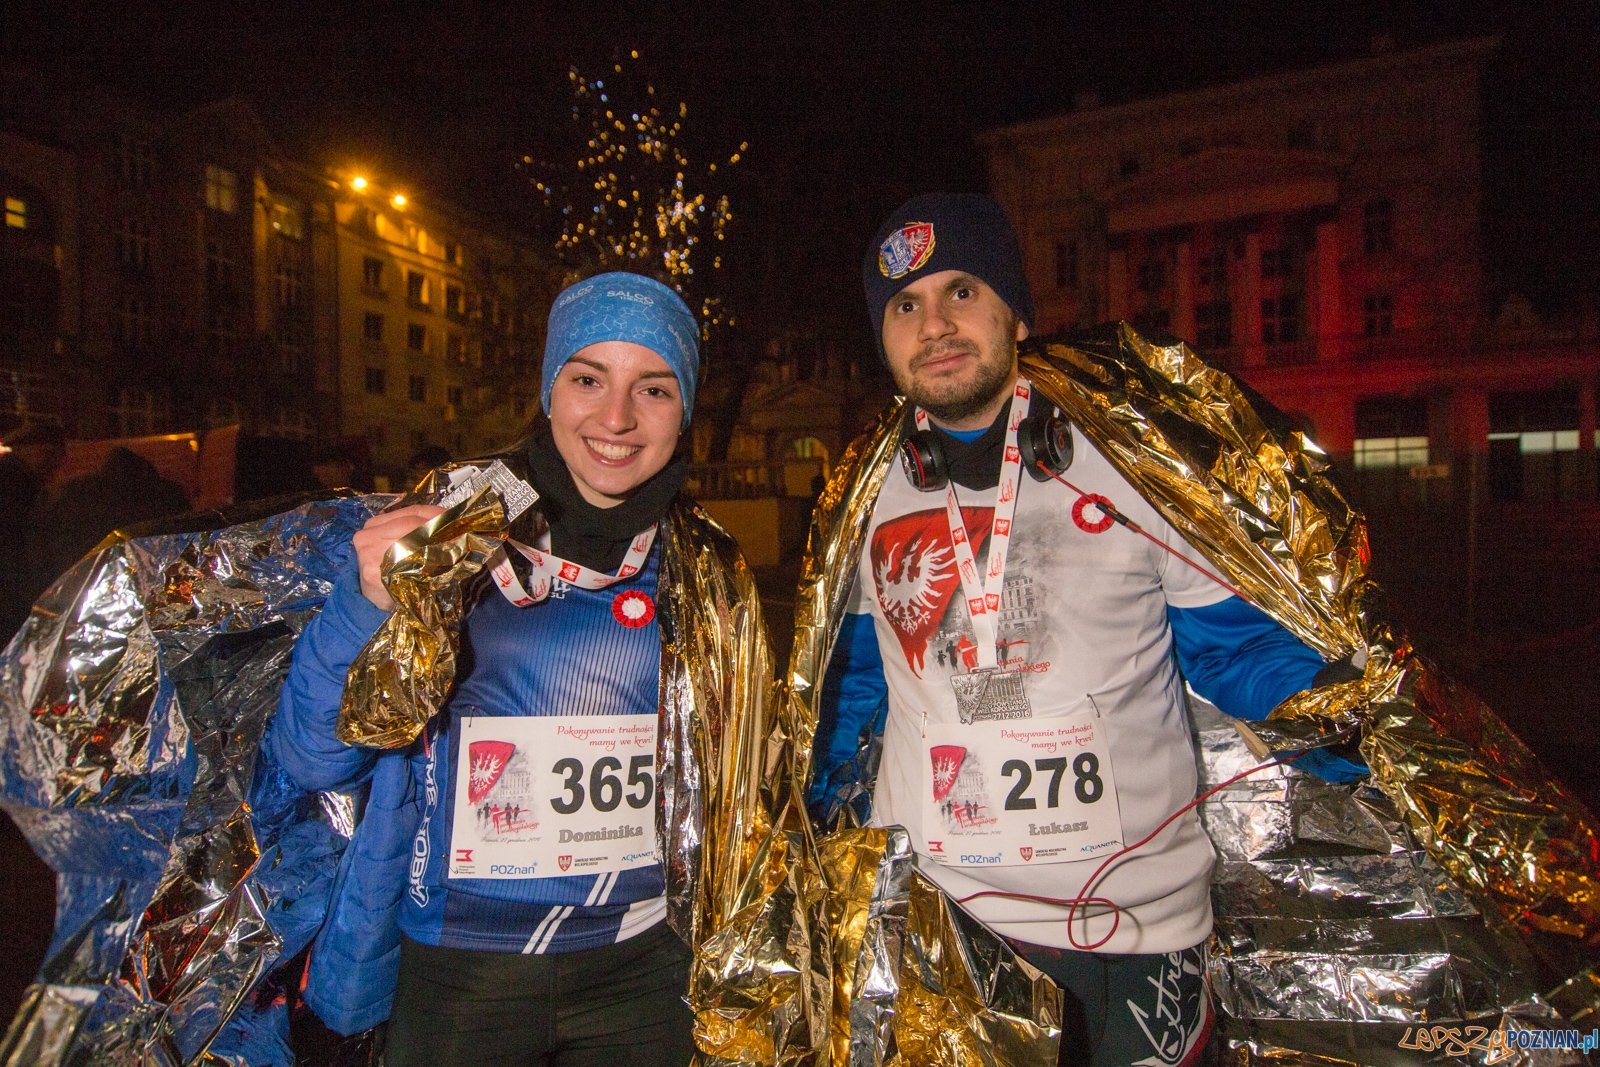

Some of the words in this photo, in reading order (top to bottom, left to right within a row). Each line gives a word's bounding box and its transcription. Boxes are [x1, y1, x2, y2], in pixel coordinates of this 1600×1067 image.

[606, 290, 654, 305] SALCO
[557, 725, 615, 740] Pokonywanie
[618, 724, 654, 734] trudności
[1001, 729, 1054, 743] Pokonywanie
[1057, 723, 1092, 736] trudności
[589, 739, 616, 752] mamy
[633, 734, 654, 748] krwi!
[1031, 741, 1058, 753] mamy
[1075, 732, 1094, 747] krwi!
[549, 754, 654, 815] 365
[1001, 752, 1104, 811] 278
[558, 825, 643, 843] Dominika
[1028, 821, 1089, 836] Łukasz
